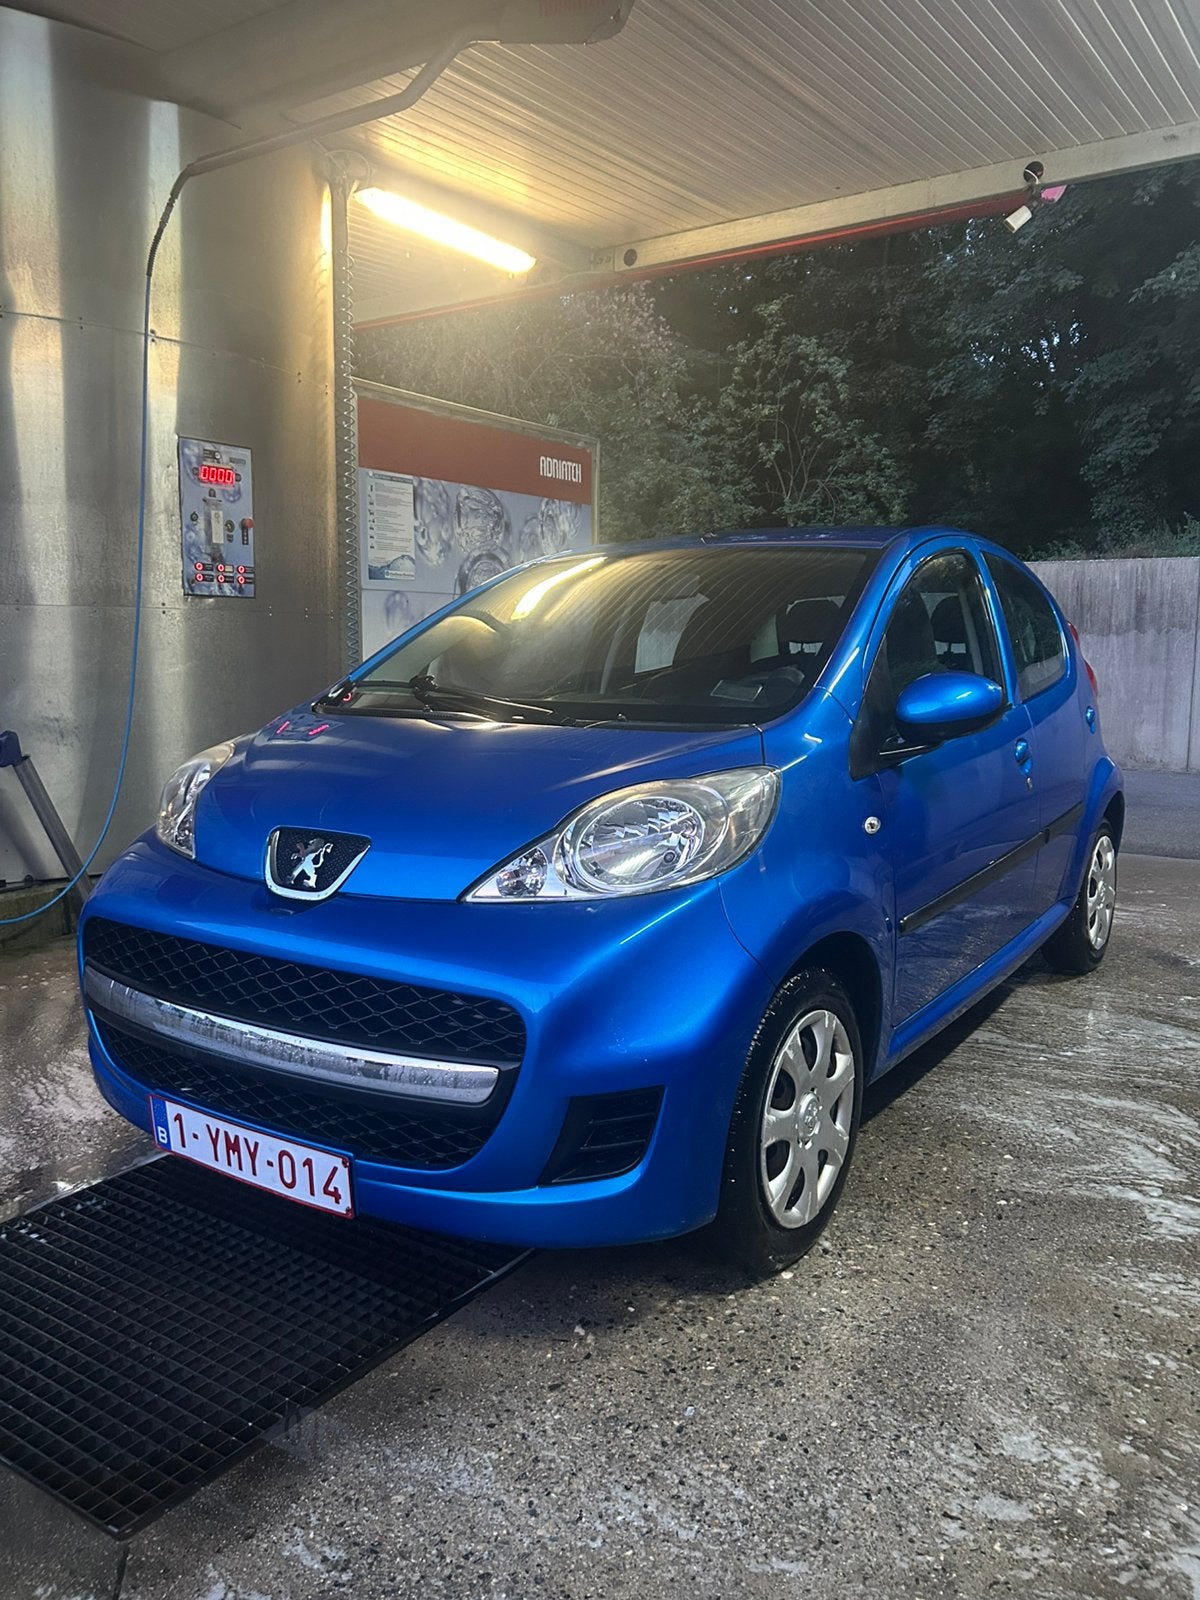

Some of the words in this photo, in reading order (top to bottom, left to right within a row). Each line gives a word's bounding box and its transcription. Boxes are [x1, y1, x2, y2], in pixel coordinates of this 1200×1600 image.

[200, 466, 233, 483] 0000
[157, 1126, 168, 1144] B
[173, 1112, 342, 1205] 1-YMY-014
